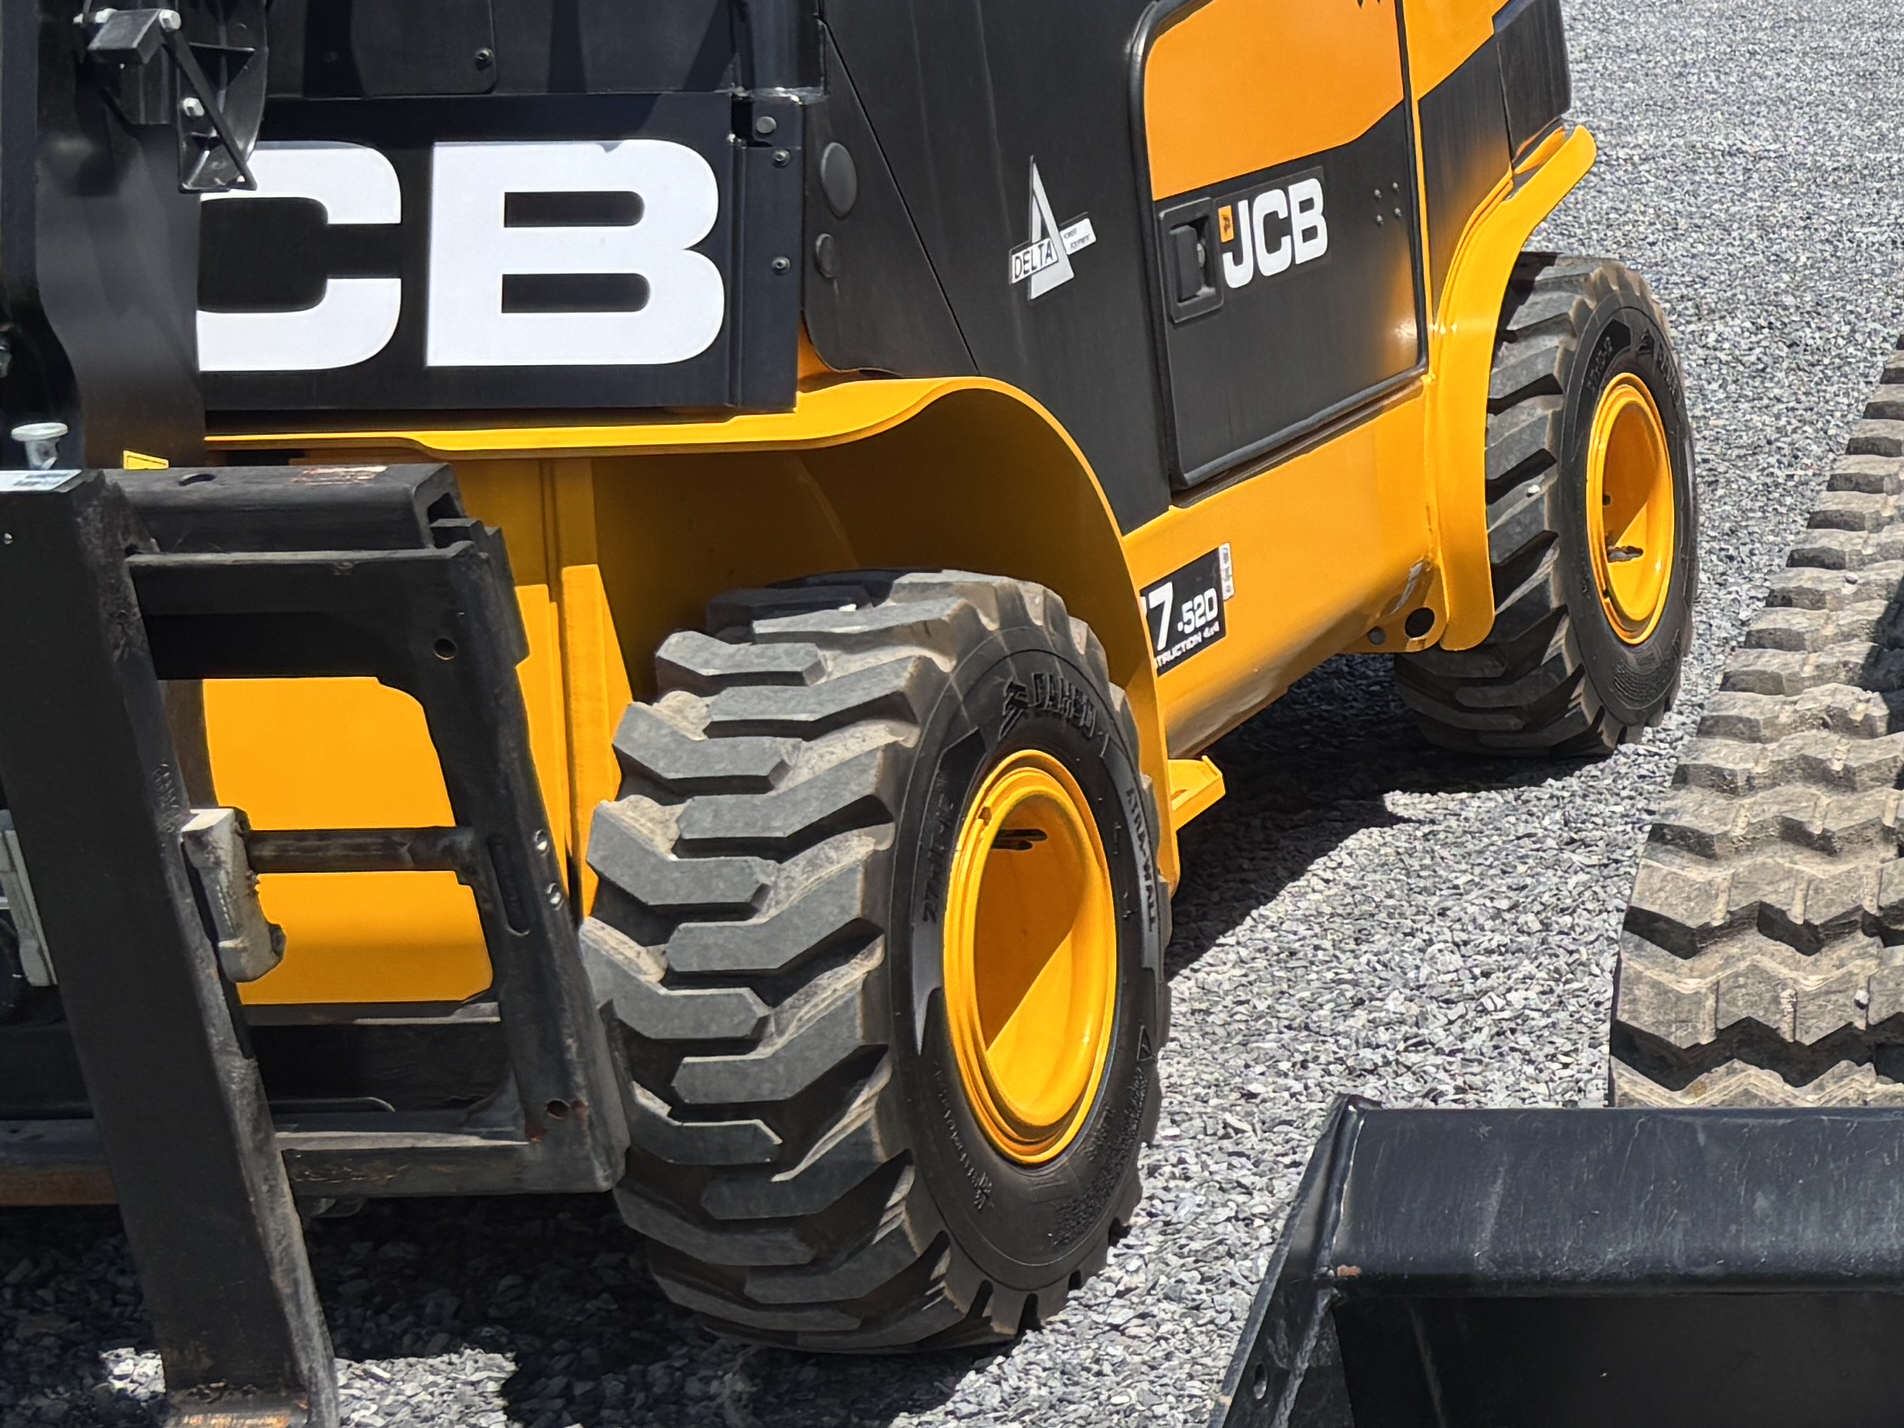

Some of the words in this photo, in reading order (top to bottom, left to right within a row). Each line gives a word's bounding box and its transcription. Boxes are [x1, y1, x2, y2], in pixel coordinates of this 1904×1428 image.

[195, 138, 725, 372] CB
[1013, 239, 1054, 280] DELTA
[1221, 177, 1329, 289] JCB
[1154, 631, 1203, 669] TRUCTION
